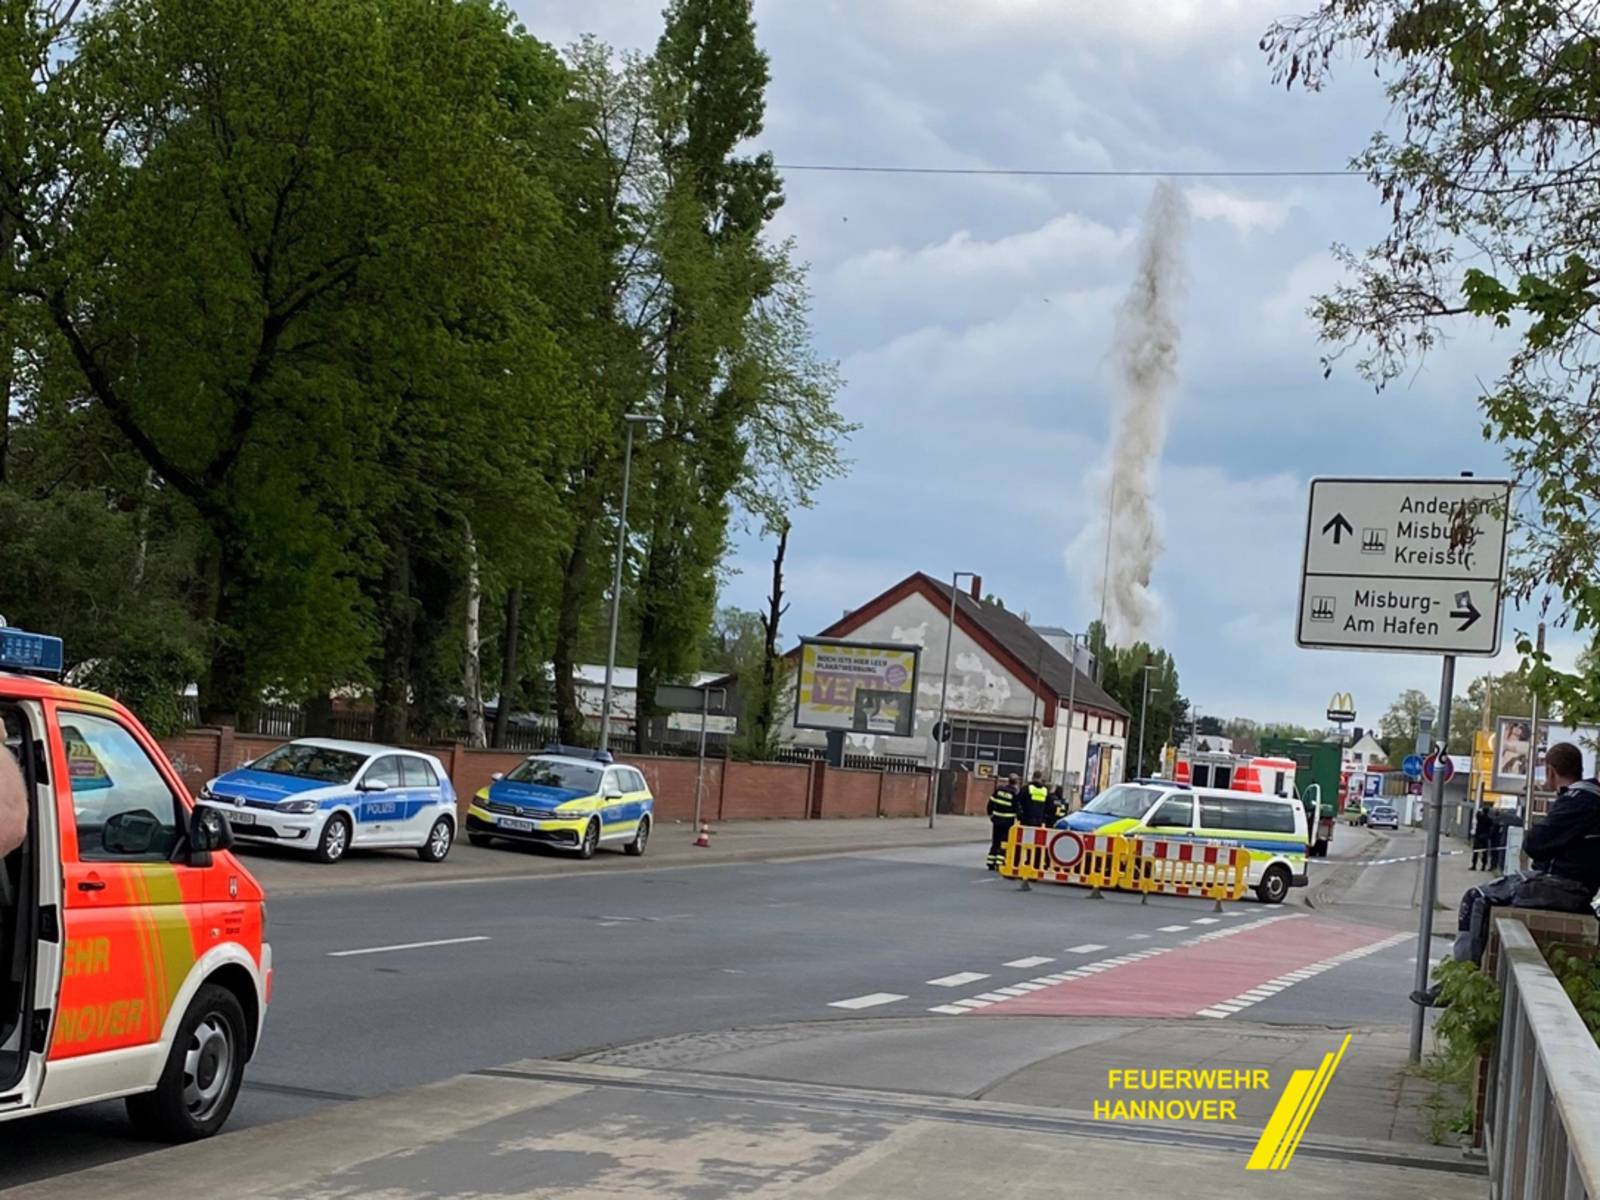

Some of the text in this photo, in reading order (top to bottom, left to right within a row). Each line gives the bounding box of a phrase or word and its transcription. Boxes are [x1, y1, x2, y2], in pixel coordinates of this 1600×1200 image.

[1354, 590, 1440, 613] Misburg-
[1343, 615, 1438, 635] Am Hafen
[366, 801, 396, 815] POLIZEI
